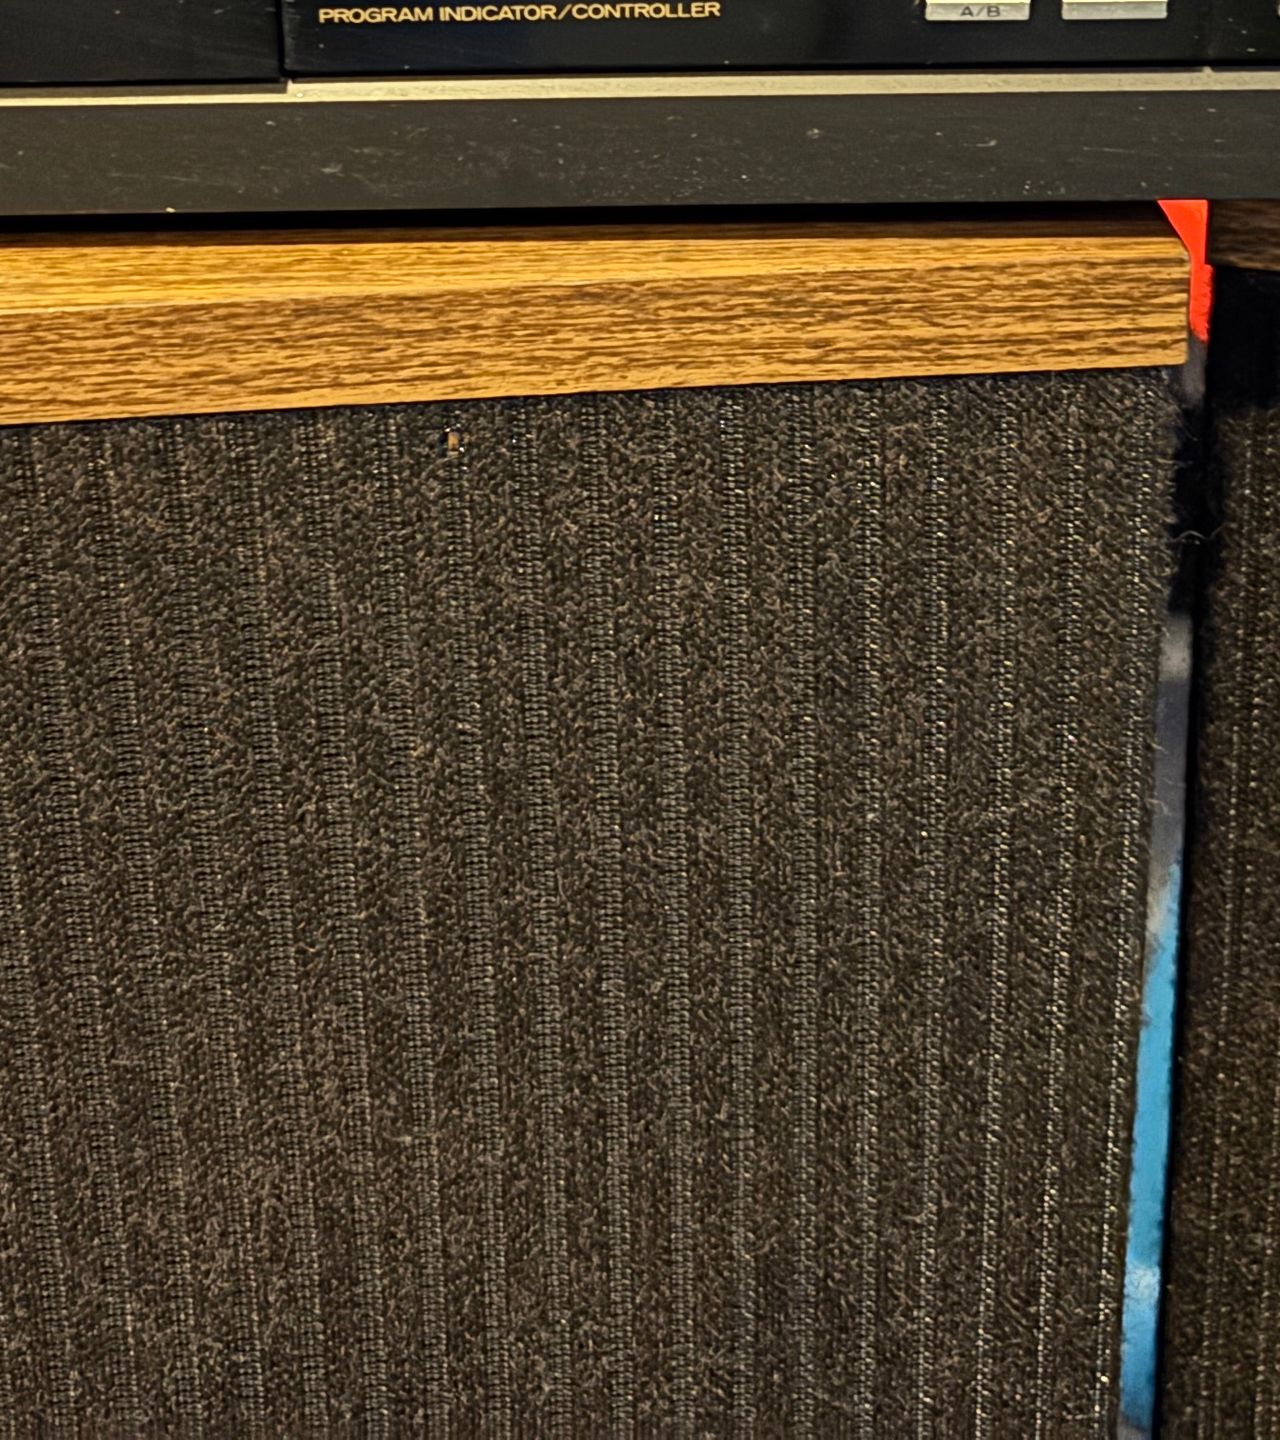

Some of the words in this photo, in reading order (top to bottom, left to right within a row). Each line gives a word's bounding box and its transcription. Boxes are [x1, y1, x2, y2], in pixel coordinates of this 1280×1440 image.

[318, 5, 434, 24] PROGRAM
[439, 1, 721, 22] INDICATOR/CONTROLLER
[960, 5, 1001, 18] A/B
